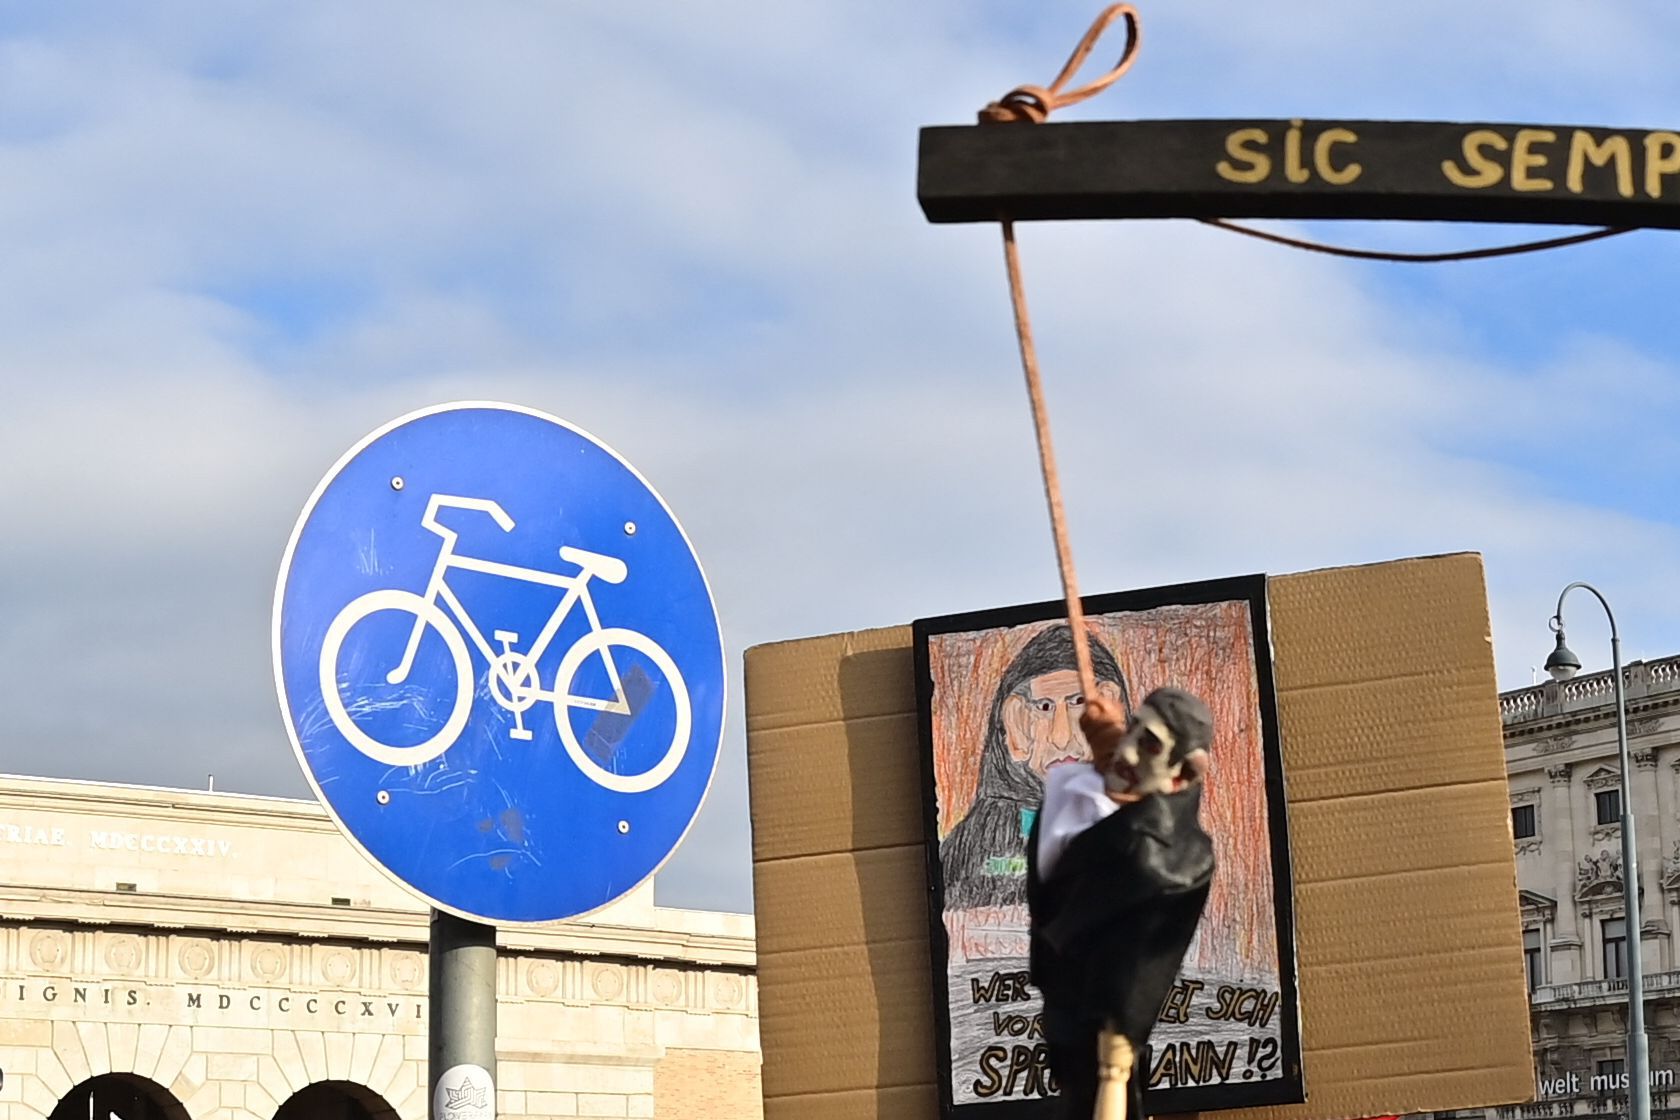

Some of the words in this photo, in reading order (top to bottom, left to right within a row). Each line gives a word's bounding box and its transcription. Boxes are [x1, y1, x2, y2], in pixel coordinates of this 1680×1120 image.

[971, 970, 1032, 1004] WER
[1206, 984, 1282, 1028] SICH
[1538, 1071, 1580, 1095] welt
[1590, 1068, 1674, 1092] musm
